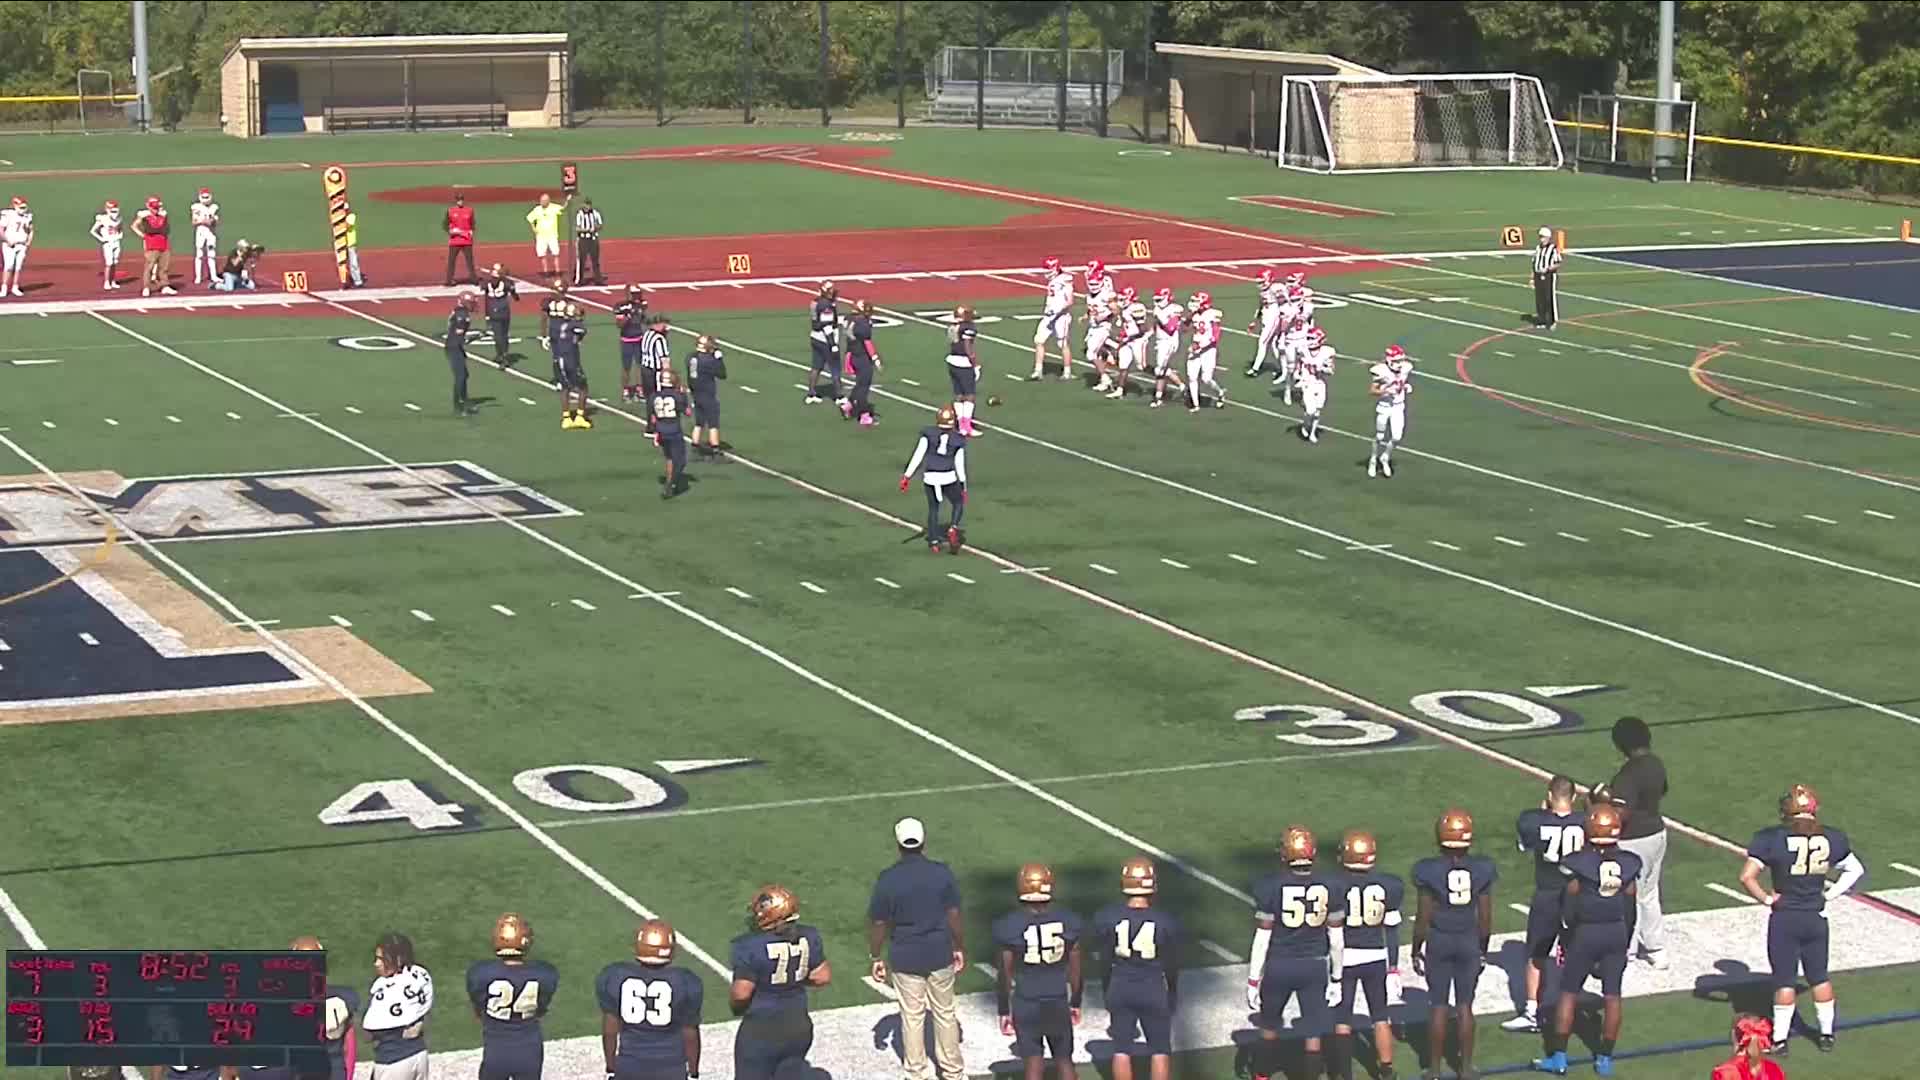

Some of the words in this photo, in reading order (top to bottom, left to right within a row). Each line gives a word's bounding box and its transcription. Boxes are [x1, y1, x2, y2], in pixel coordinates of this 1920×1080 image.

[564, 166, 576, 184] 3
[1133, 240, 1149, 257] 10
[1506, 229, 1522, 245] G
[287, 272, 305, 289] 30
[731, 255, 749, 273] 20
[938, 433, 949, 455] 1
[1233, 689, 1562, 747] 30
[317, 764, 669, 831] 40
[1538, 824, 1585, 863] 70
[1786, 834, 1830, 876] 72
[1446, 869, 1472, 905] 9
[1597, 860, 1622, 897] 6
[1280, 883, 1329, 929] 53
[1345, 883, 1386, 928] 16
[1022, 920, 1066, 965] 15
[1114, 918, 1157, 961] 14
[766, 937, 811, 986] 77
[389, 1002, 403, 1017] G
[485, 979, 540, 1021] 24
[619, 977, 673, 1027] 63
